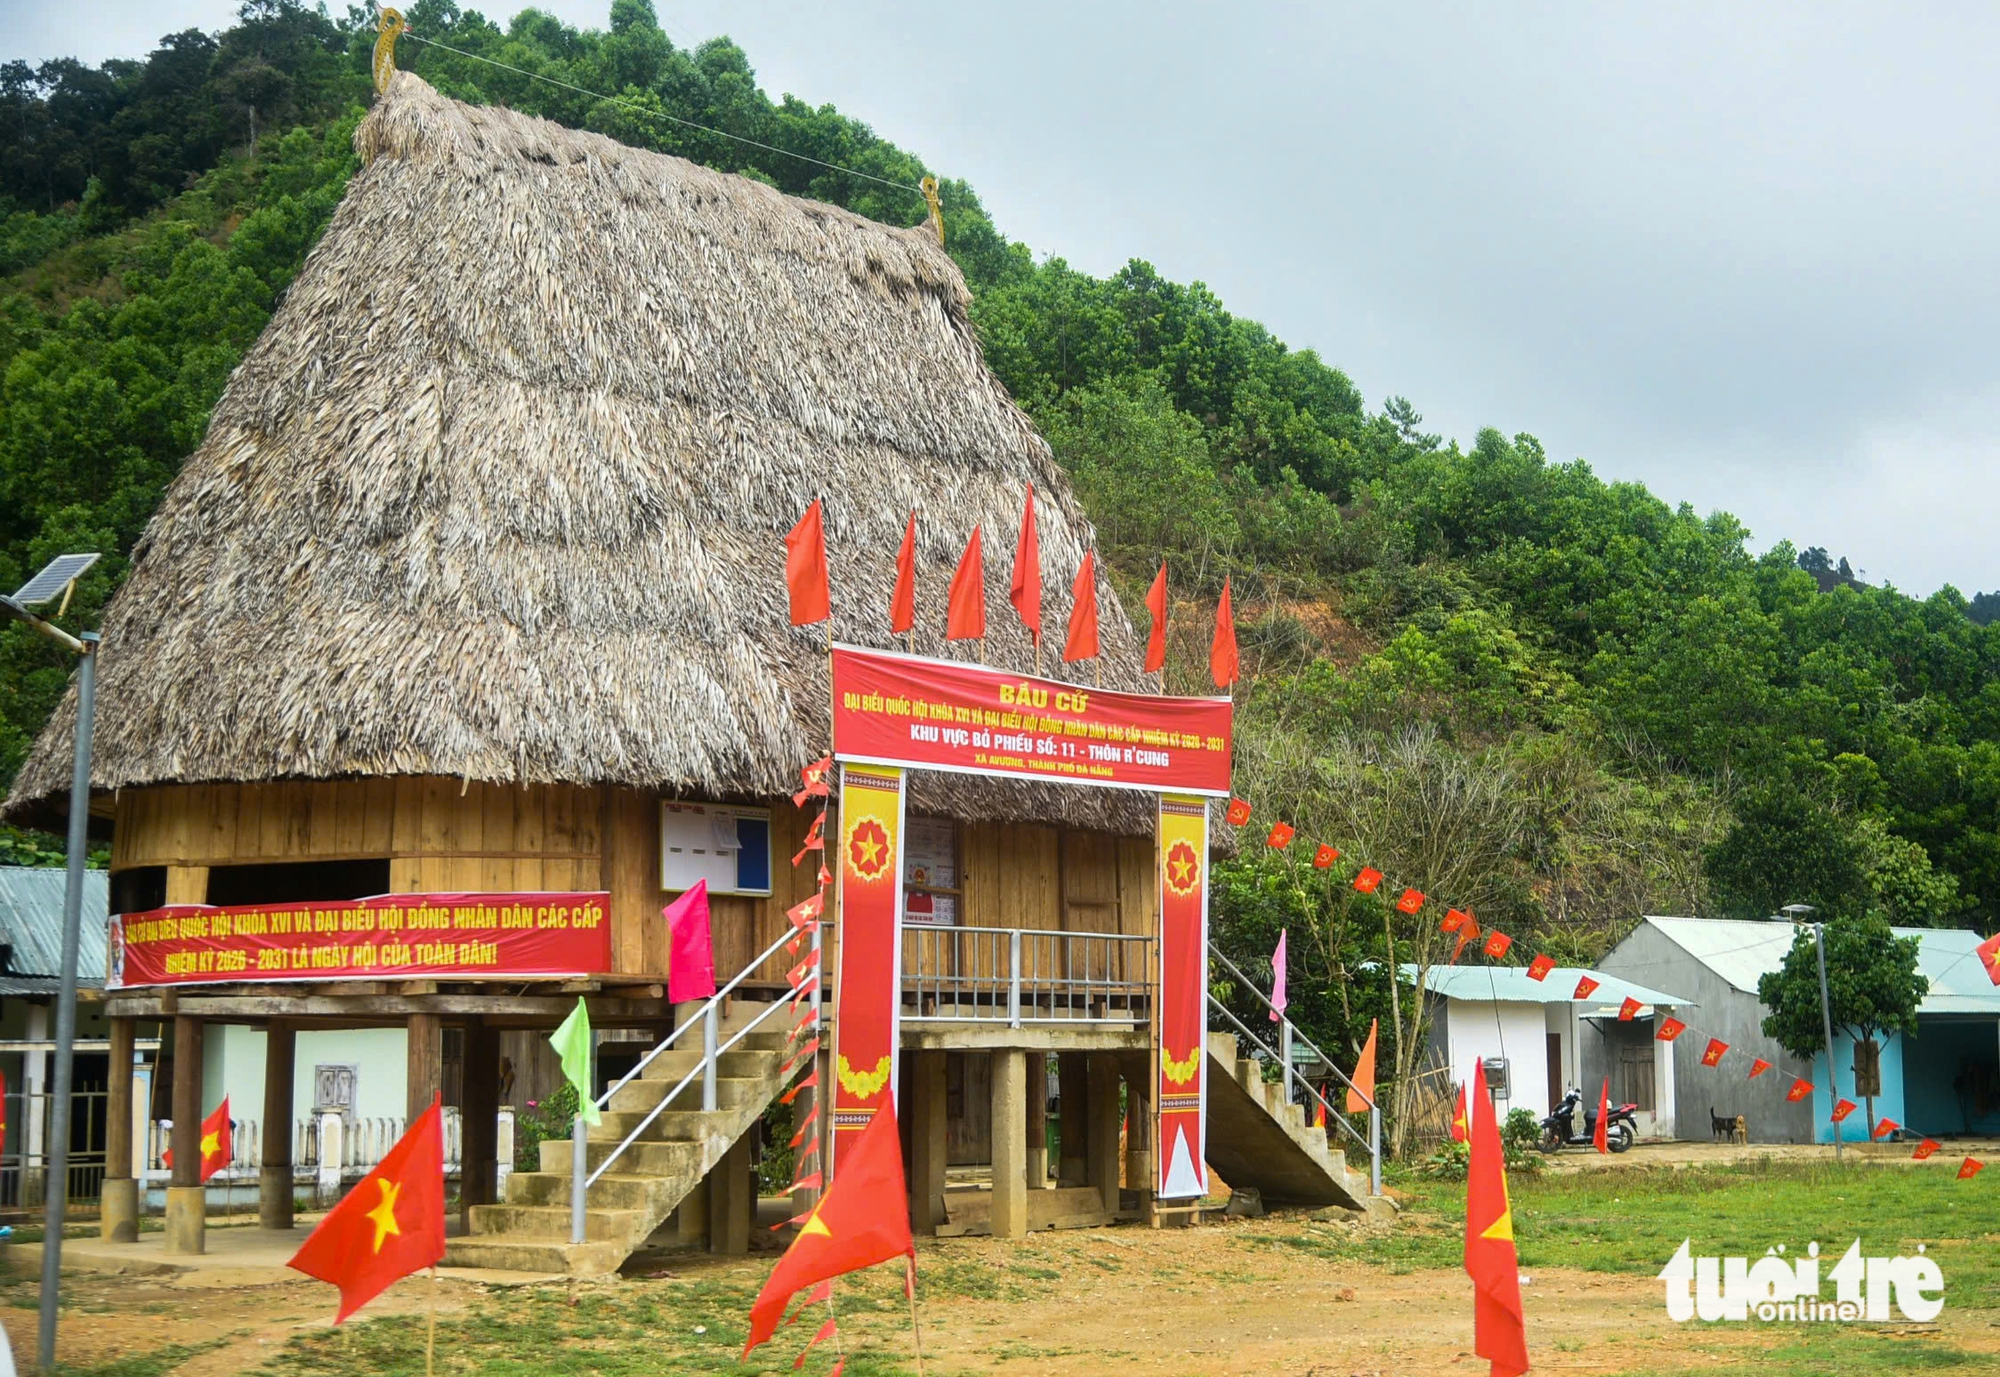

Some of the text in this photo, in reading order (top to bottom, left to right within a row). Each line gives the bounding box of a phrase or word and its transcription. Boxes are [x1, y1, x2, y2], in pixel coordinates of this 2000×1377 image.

[999, 681, 1089, 713] BẦU CỬ
[844, 692, 860, 713] ĐẠI
[862, 690, 884, 711] BIỂU
[886, 694, 910, 716] QUỐC
[912, 699, 928, 721] HỘI
[930, 701, 953, 721] KHÓA
[955, 707, 970, 723] XVI
[971, 707, 983, 725] VÀ
[984, 710, 999, 729] ĐẠI
[1001, 708, 1022, 730] BIỂU
[1023, 714, 1038, 734] HỘI
[1039, 713, 1062, 734] ĐỒNG
[1206, 736, 1224, 752] 2031
[910, 724, 938, 743] KHU
[942, 727, 969, 748] VỰC
[972, 728, 990, 748] BỎ
[994, 733, 1032, 754] PHIẾU
[1036, 736, 1057, 756] SỐ:
[1061, 742, 1075, 757] 11
[1088, 744, 1121, 763] THÔN
[1028, 758, 1056, 772] THÀNH
[179, 909, 208, 940] QUỐC
[211, 911, 231, 940] HỘI
[234, 909, 268, 935] KHÓA
[271, 911, 292, 934] XVI
[294, 906, 312, 933] VÀ
[315, 909, 338, 937] ĐẠI
[342, 901, 375, 931] BIỂU
[378, 904, 404, 935] HỘI
[407, 901, 450, 930] ĐỒNG
[453, 903, 497, 929] NHÂN
[501, 903, 533, 929] DÂN
[537, 902, 568, 929] CÁC
[572, 900, 602, 929] CẤP
[165, 948, 197, 977] NHIỆM
[199, 947, 215, 972] KỲ
[216, 950, 247, 971] 2026
[257, 948, 288, 970] 2031
[292, 942, 308, 969] LÀ
[312, 941, 349, 968] NGÀY
[352, 940, 377, 971] HỘI
[381, 937, 412, 966] CỦA
[415, 939, 456, 965] TOÀN
[459, 939, 497, 965] DÂN!
